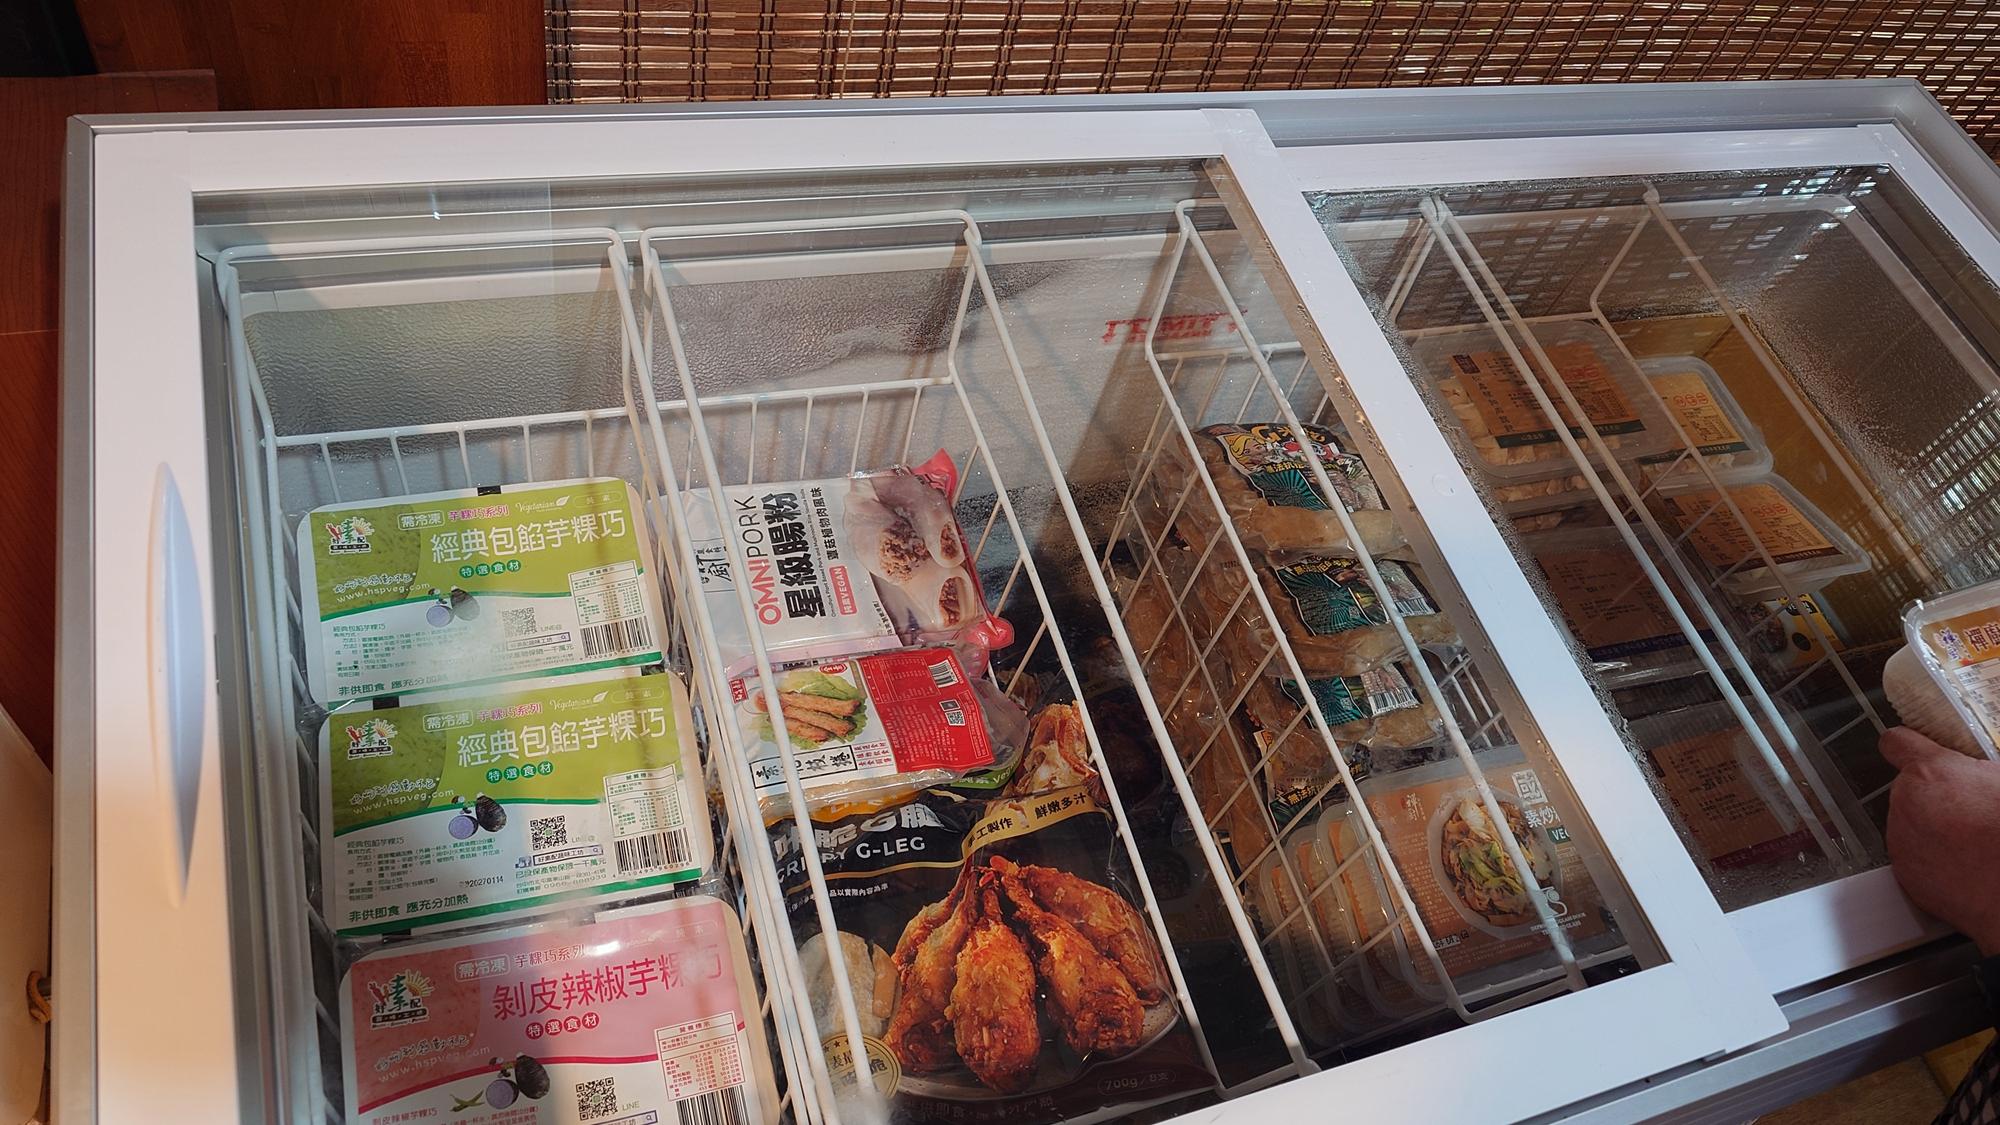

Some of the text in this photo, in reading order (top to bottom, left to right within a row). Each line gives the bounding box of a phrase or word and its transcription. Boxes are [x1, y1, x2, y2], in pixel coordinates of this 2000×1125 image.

[401, 513, 442, 528] 需冷凍
[430, 509, 627, 564] 經典包餡芋粿巧
[761, 493, 827, 619] 星級腸粉
[337, 582, 431, 604] www.hspveg.com
[339, 682, 385, 697] 非供即食
[426, 713, 471, 730] 需冷凍
[457, 707, 666, 768] 經典包餡芋粿巧
[487, 762, 552, 783] 特選食材
[755, 751, 852, 780] 素枝捲
[353, 789, 454, 815] www.hspveg.com
[1034, 791, 1087, 820] 鮮嫩多汁
[777, 836, 926, 884] CRIPY G-LEG
[349, 893, 469, 922] 非供即食 應充分加熱
[526, 1012, 599, 1038] 特選食材
